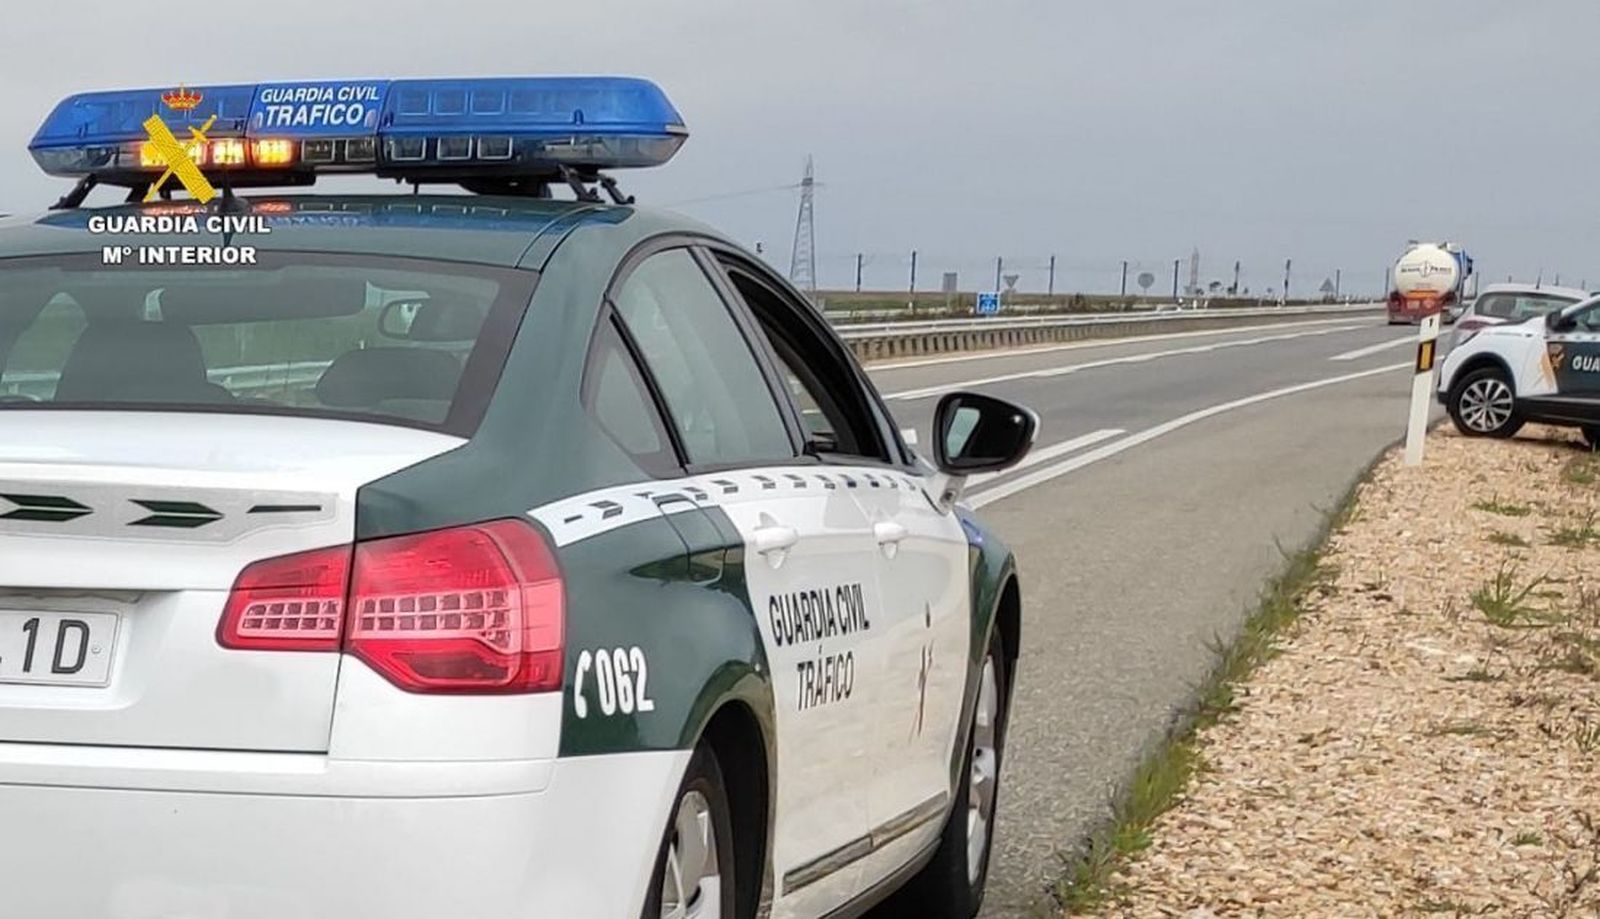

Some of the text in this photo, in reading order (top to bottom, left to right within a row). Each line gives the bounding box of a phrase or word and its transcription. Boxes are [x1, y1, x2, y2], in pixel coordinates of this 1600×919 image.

[261, 86, 380, 103] GUARDIA CIVIL
[265, 103, 364, 126] TRAFICO
[0, 617, 90, 674] 1D
[769, 584, 870, 647] GUARDIA CIVIL
[597, 646, 654, 716] 062
[797, 645, 854, 711] TRÁFICO
